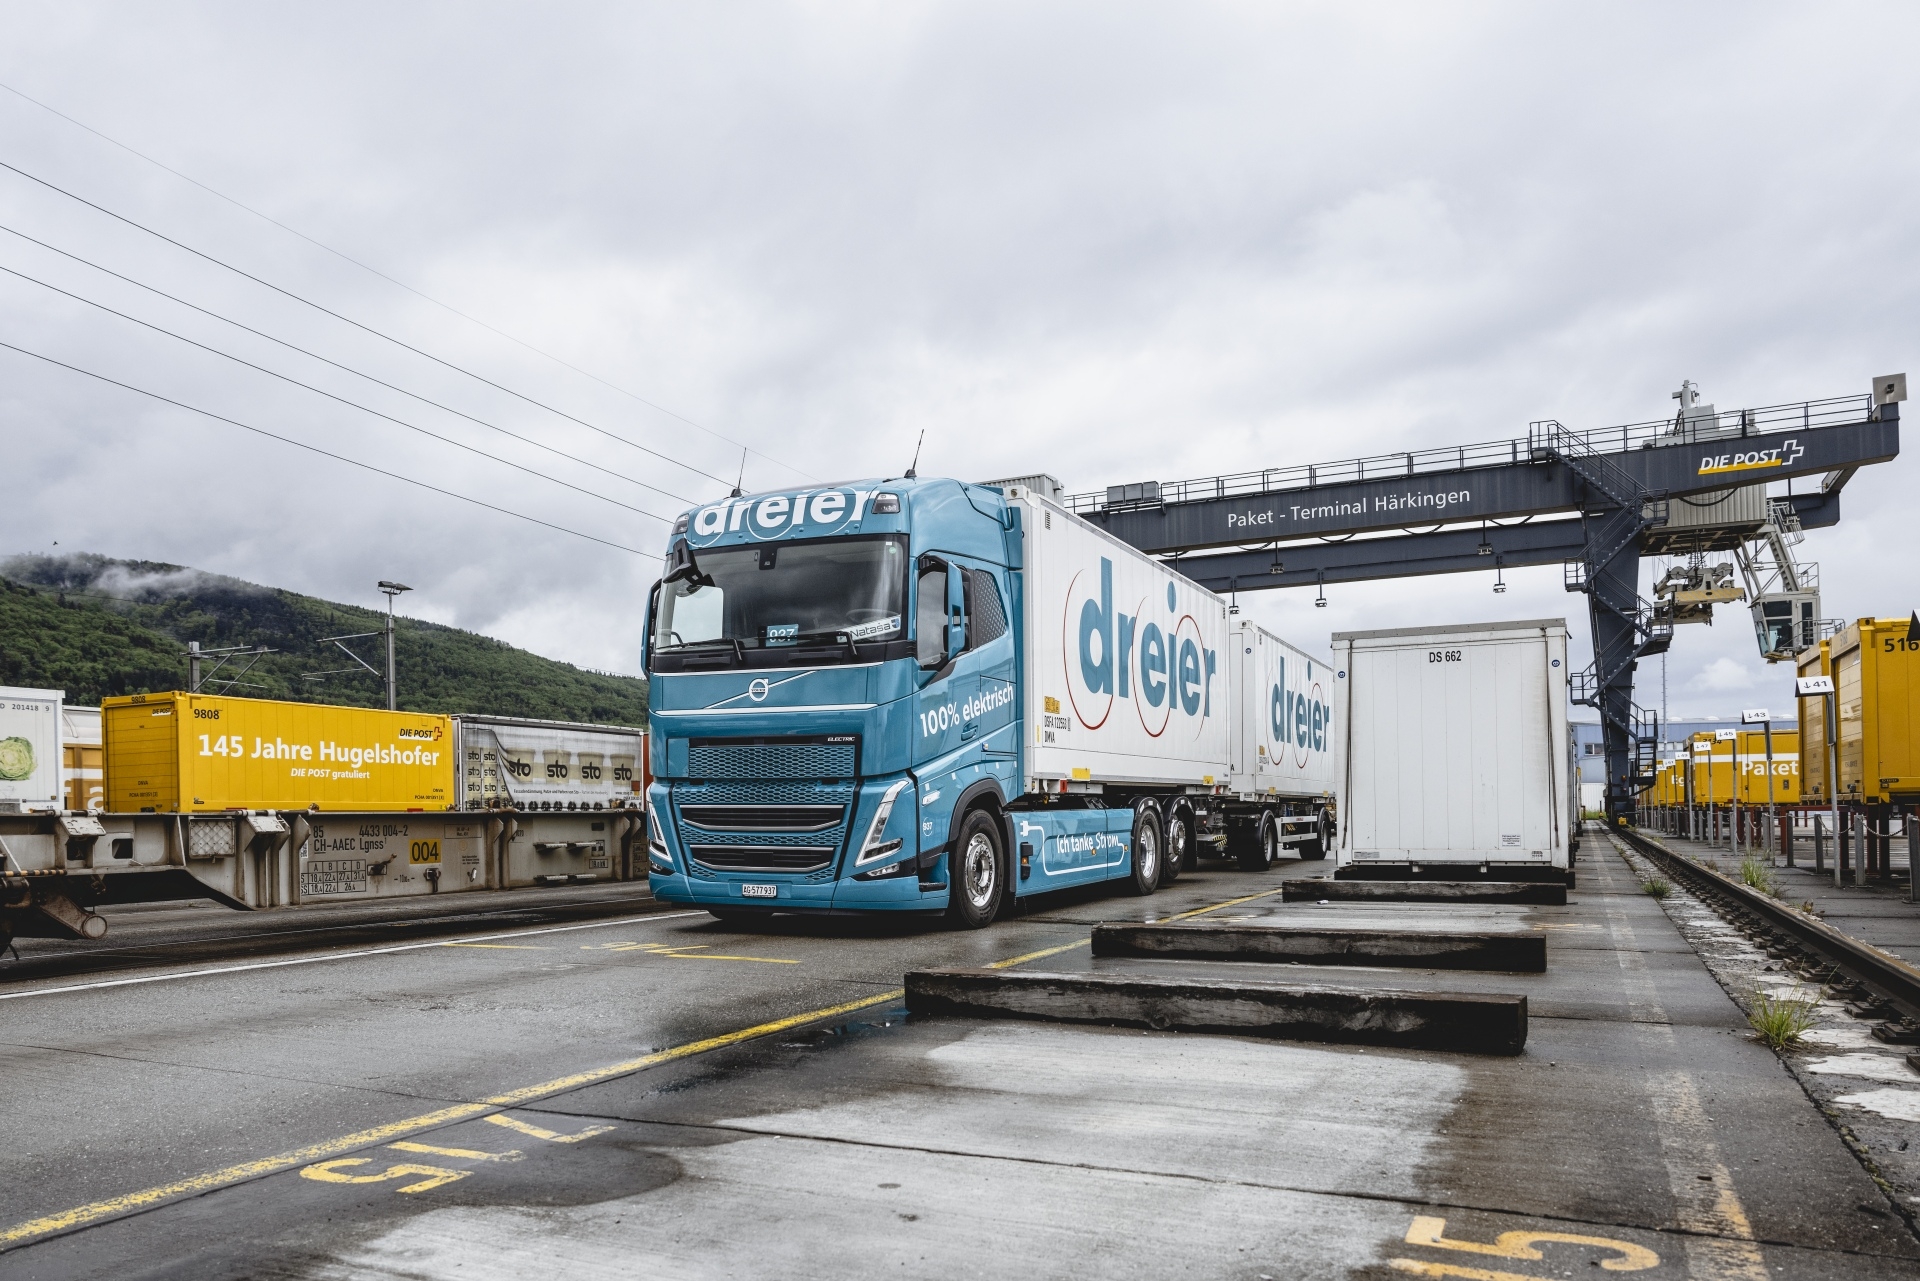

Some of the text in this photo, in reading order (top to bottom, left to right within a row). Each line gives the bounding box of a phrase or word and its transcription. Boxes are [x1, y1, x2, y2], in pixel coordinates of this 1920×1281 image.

[1700, 449, 1781, 471] DIE POST
[1227, 509, 1274, 527] Paket
[1290, 497, 1368, 521] Terminal
[1375, 490, 1471, 513] Härkingen
[1079, 555, 1216, 717] dreier
[1429, 650, 1462, 663] DS 662
[12, 703, 39, 712] 201418
[920, 701, 960, 738] 100%
[963, 682, 1014, 722] elektrisch
[1271, 656, 1329, 752] dreier
[194, 709, 220, 719] 9808
[399, 728, 433, 739] DIE POST
[198, 734, 440, 768] 145 Jahre Hugelshofer
[468, 751, 496, 761] sto sto
[291, 767, 370, 780] DIE POST gratuliert
[468, 766, 496, 776] sto sto
[508, 758, 633, 781] sto sto sto sto
[1741, 759, 1799, 776] Paket
[468, 782, 481, 792] sto
[484, 783, 496, 792] sto
[313, 824, 408, 838] 85 4433 004-2
[922, 822, 933, 830] 937
[313, 838, 356, 852] CH-AAEC
[1057, 831, 1119, 854] Ich tanke Strom
[411, 841, 439, 861] 004
[313, 861, 361, 872] A B C D
[751, 886, 776, 894] 577937
